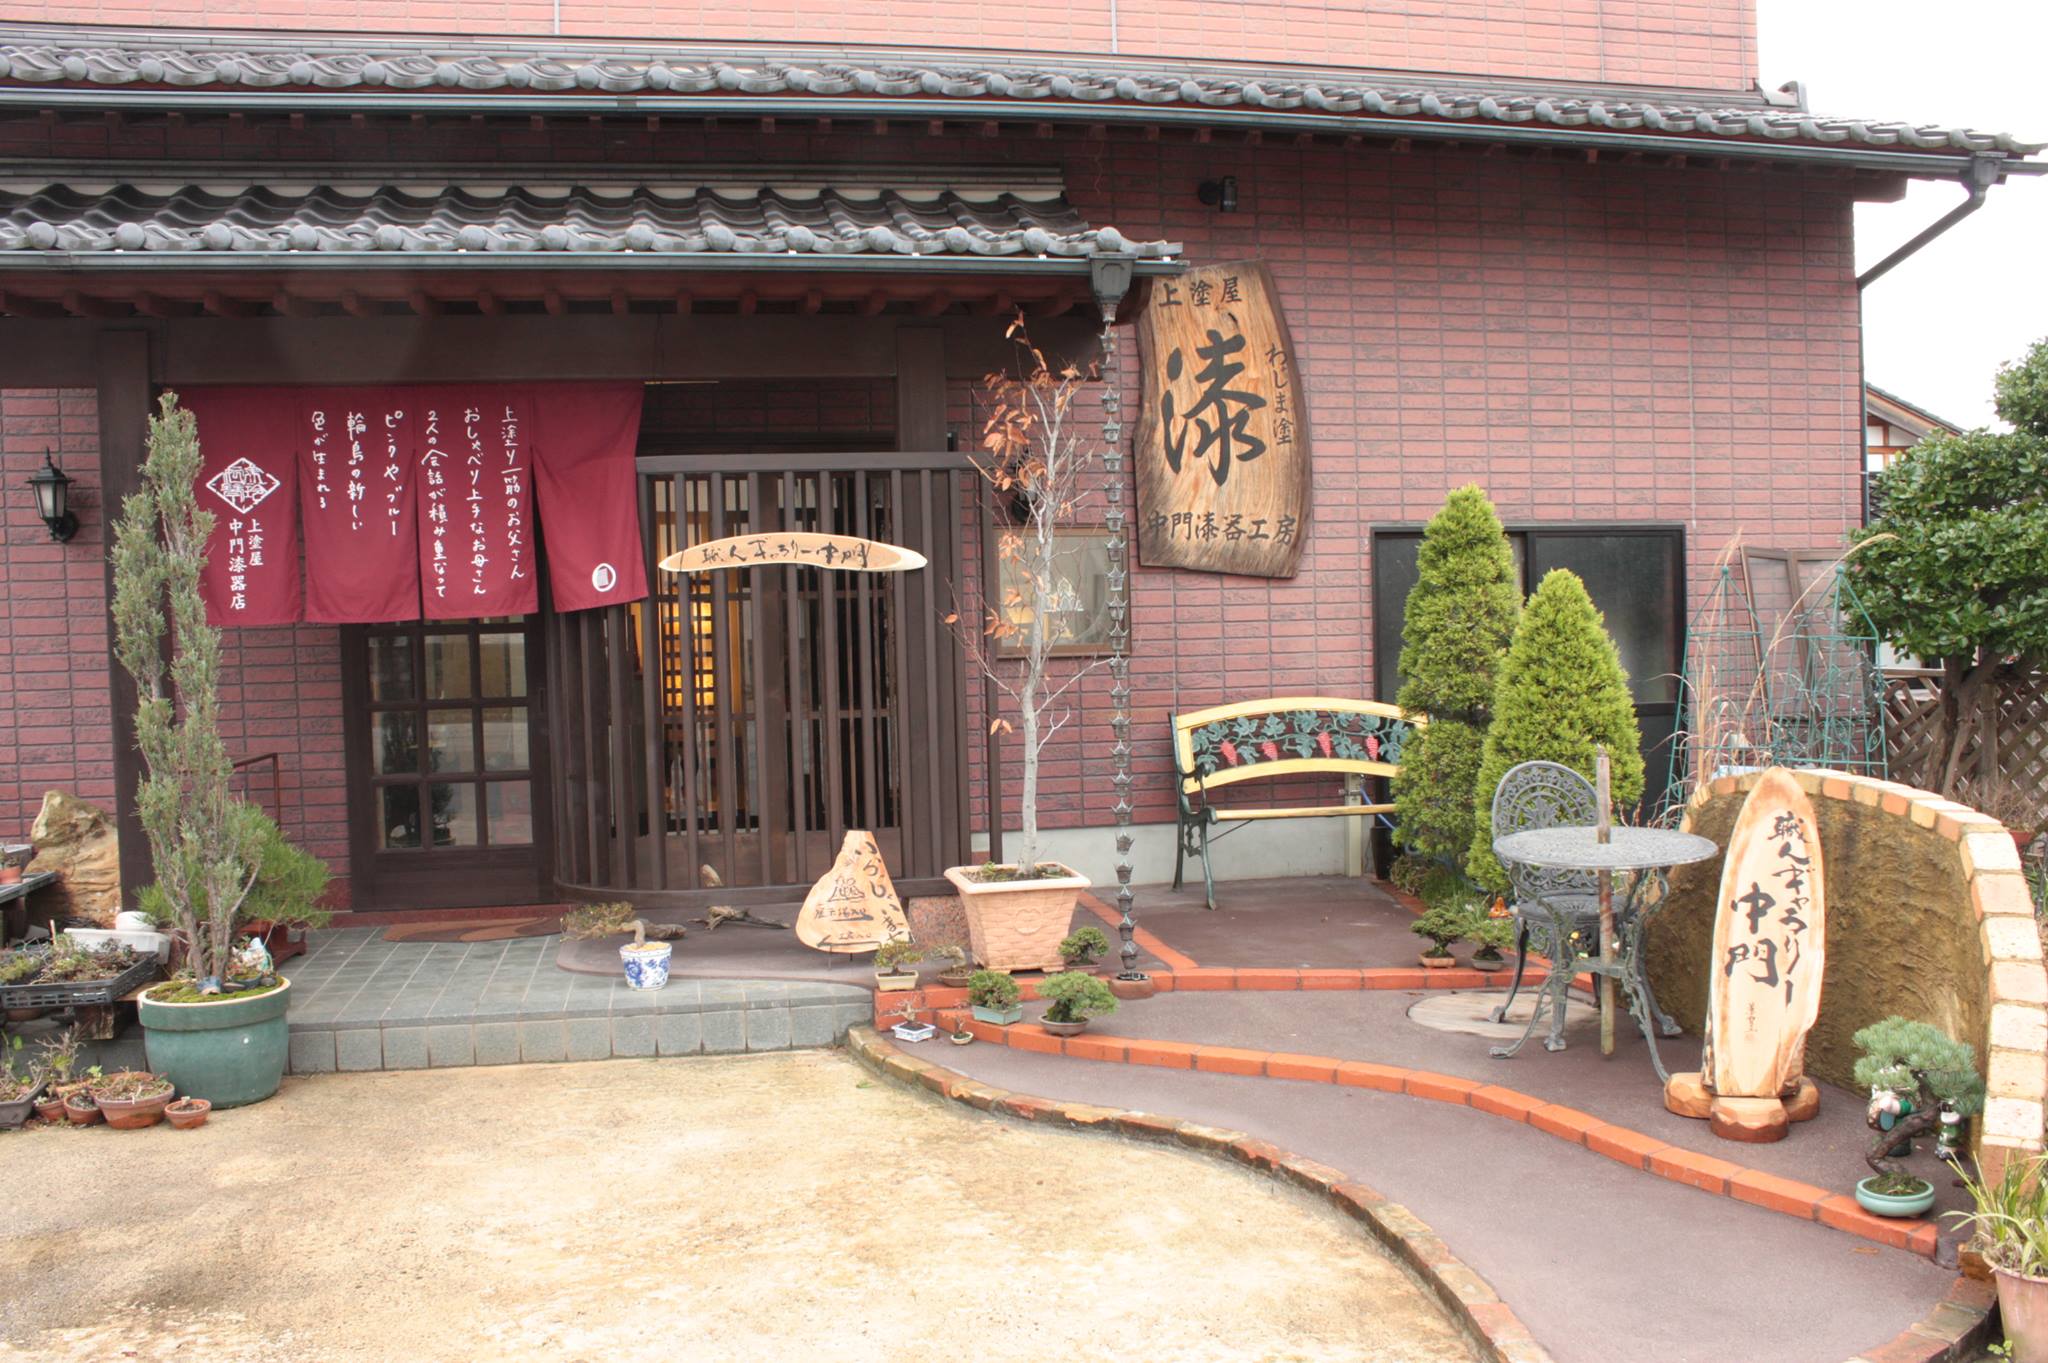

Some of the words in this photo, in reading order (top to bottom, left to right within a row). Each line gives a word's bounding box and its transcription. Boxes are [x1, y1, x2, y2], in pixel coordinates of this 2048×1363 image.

[1158, 276, 1242, 307] 上塗屋
[311, 411, 331, 509] 色が生まれる
[1161, 329, 1267, 487] 漆
[347, 411, 366, 530] 輪島の新しい
[384, 410, 404, 536] ピンクやブルー
[421, 410, 448, 598] 2人の会話が積み重なって
[464, 408, 489, 595] おしゃべり上手なお母さん
[501, 406, 525, 579] 上塗り一筋のお父さん
[228, 518, 248, 610] 中門漆器店
[247, 518, 264, 566] 上塗屋
[1148, 511, 1297, 545] 中門漆器工房
[1724, 881, 1779, 988] 中門
